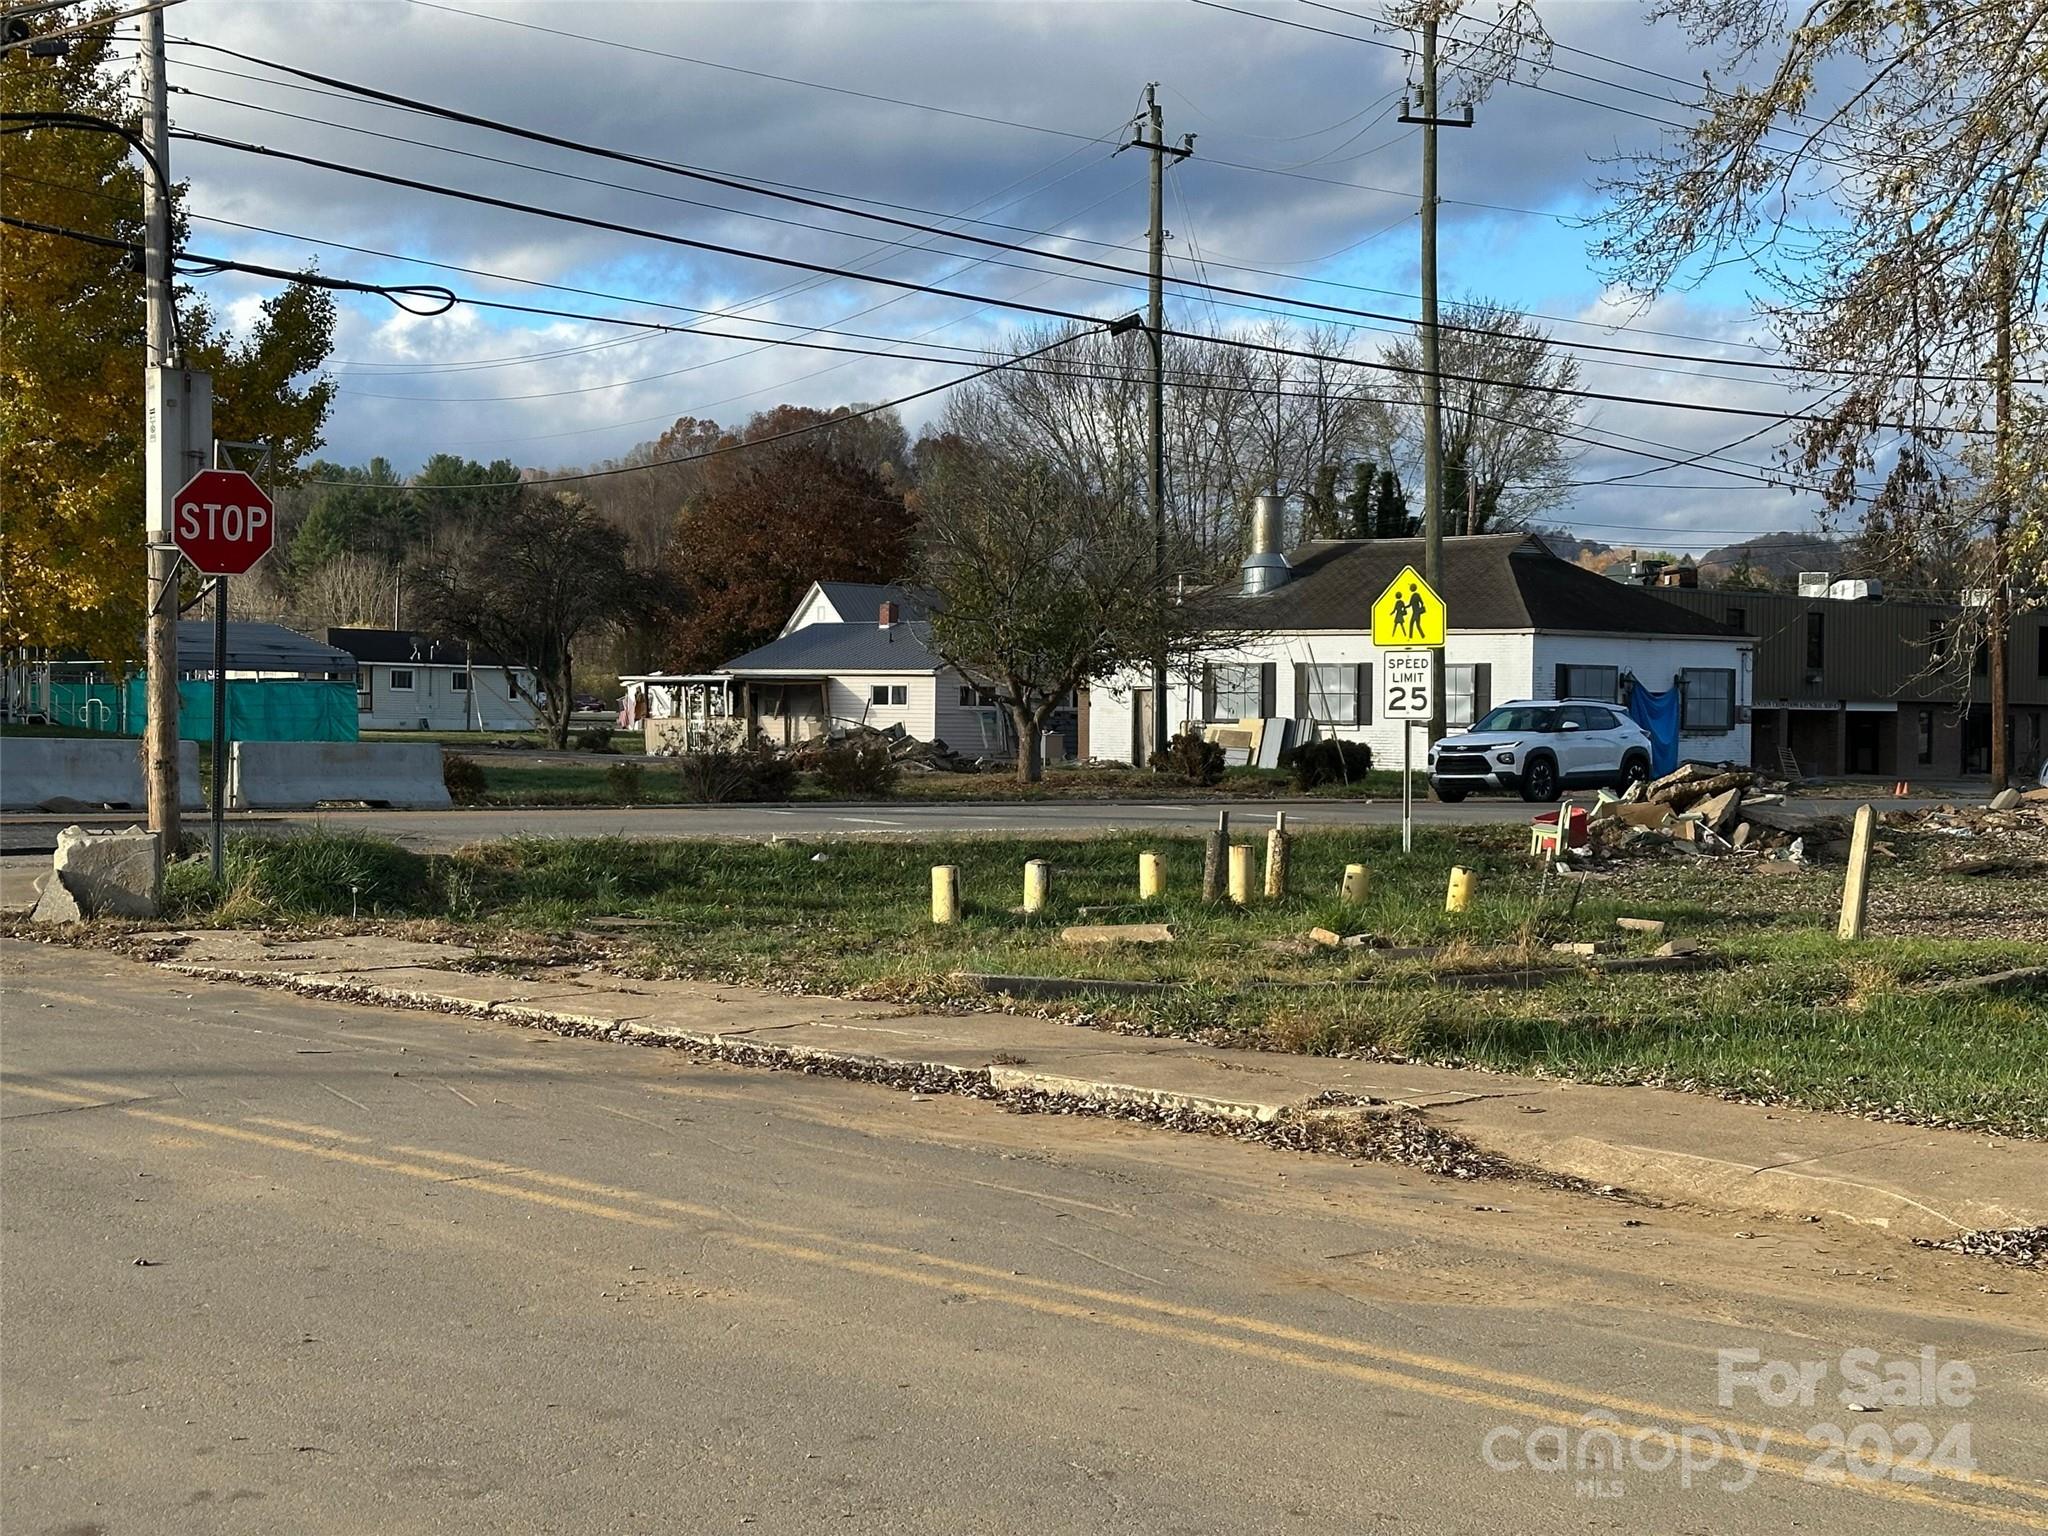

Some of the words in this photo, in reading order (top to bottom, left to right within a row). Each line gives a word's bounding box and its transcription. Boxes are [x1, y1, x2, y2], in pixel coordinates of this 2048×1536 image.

[180, 502, 267, 542] STOP
[1388, 658, 1429, 669] SPEED
[1392, 672, 1424, 683] LIMIT
[1388, 686, 1428, 711] 25
